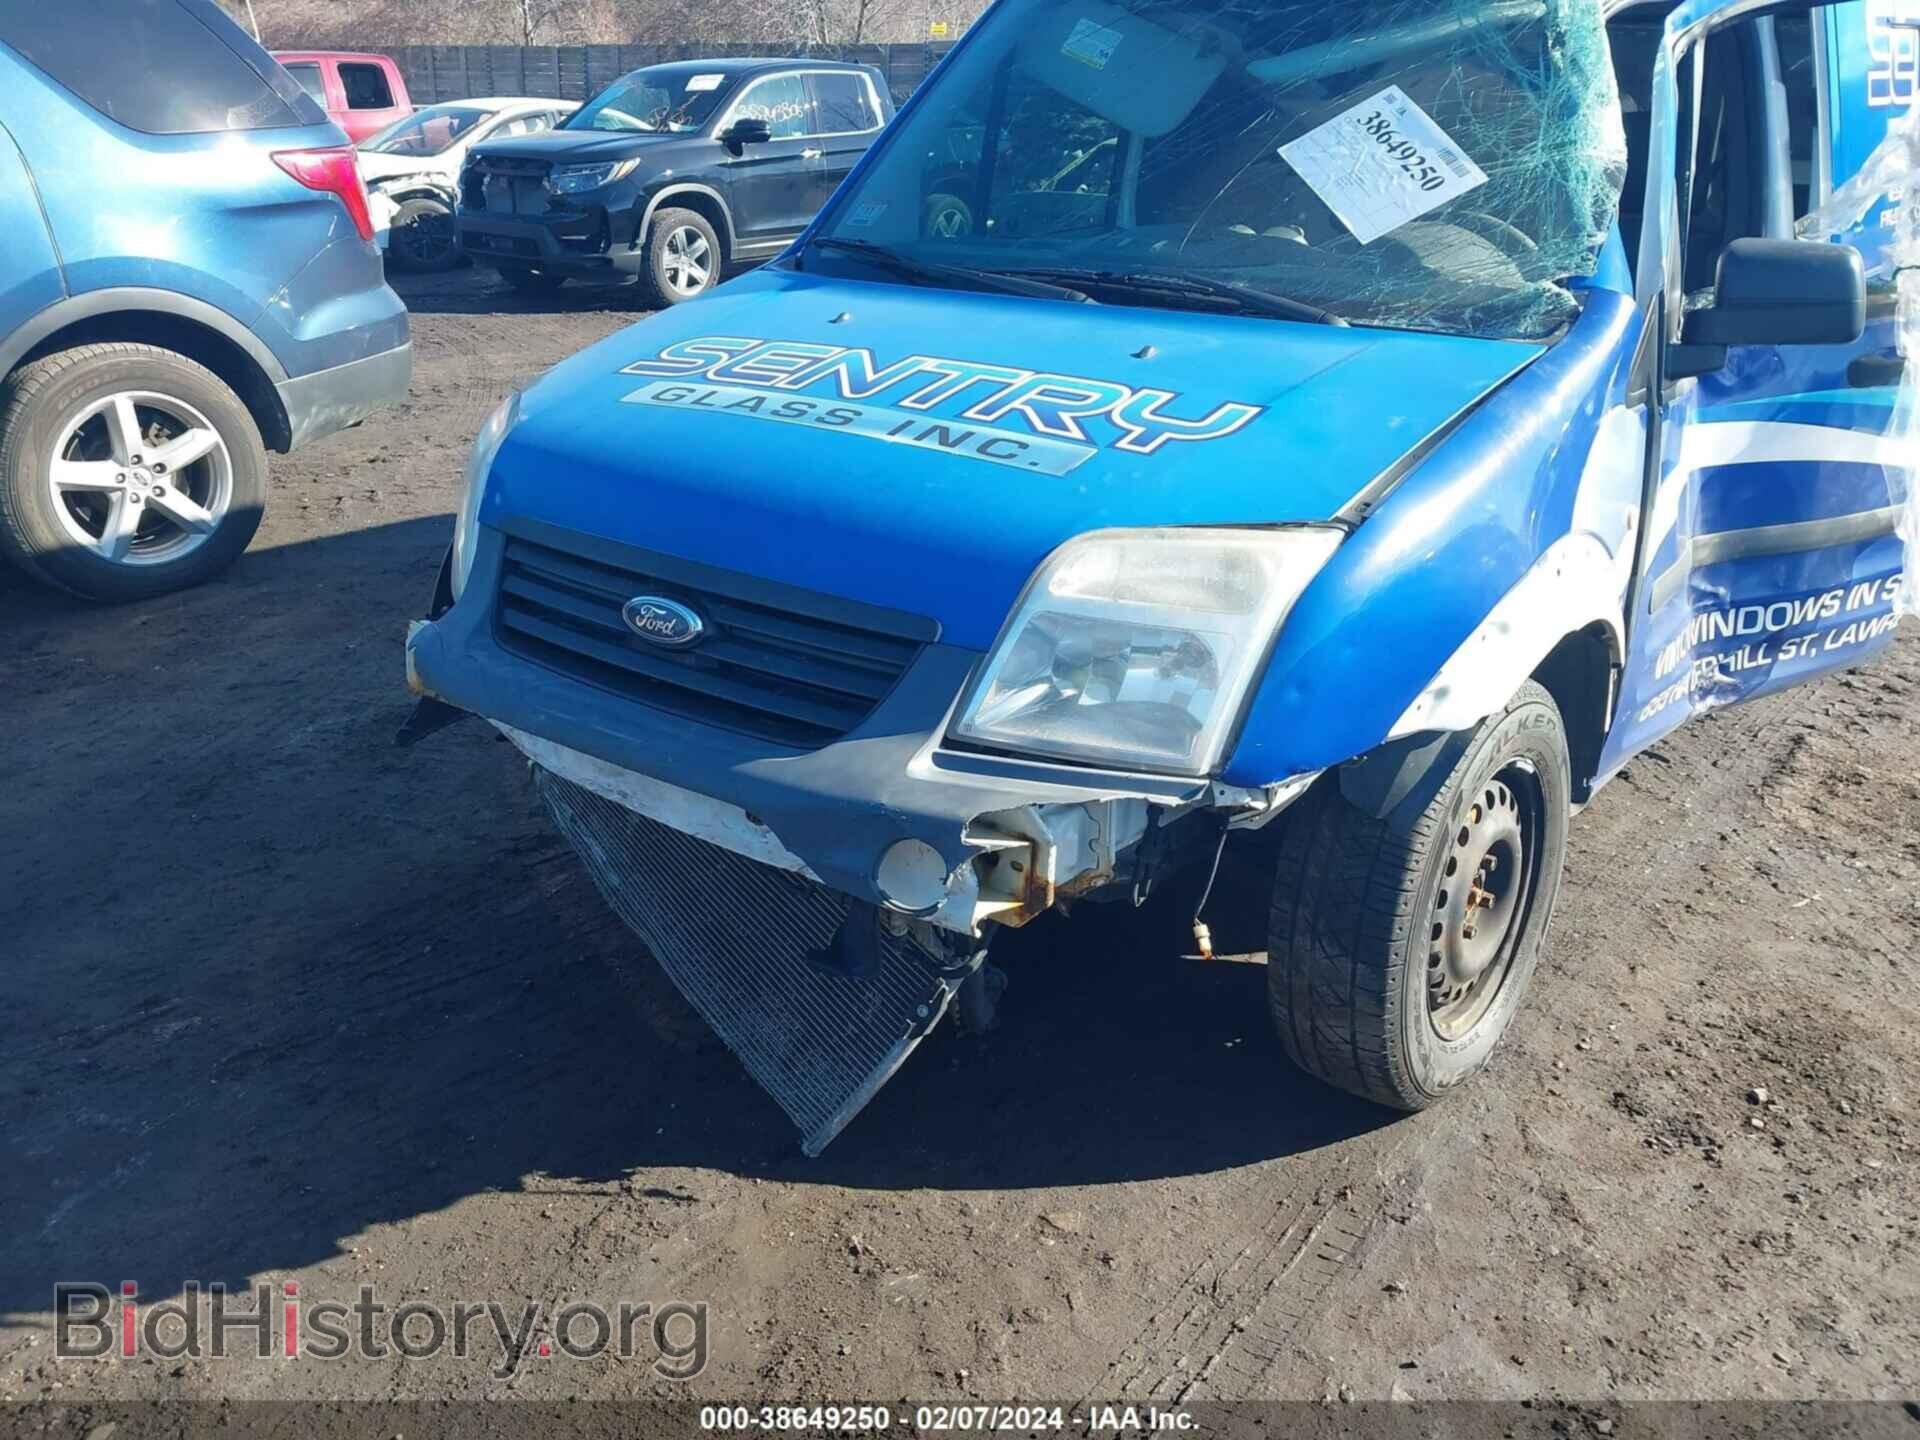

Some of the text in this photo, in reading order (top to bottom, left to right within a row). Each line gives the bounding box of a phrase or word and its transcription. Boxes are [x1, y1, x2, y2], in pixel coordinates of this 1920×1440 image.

[1356, 110, 1446, 192] 38649250
[616, 336, 1266, 455] SENTRY
[650, 386, 1041, 466] GLASS INC.
[635, 605, 676, 636] Ford
[1846, 579, 1882, 611] IN
[1881, 573, 1904, 600] S
